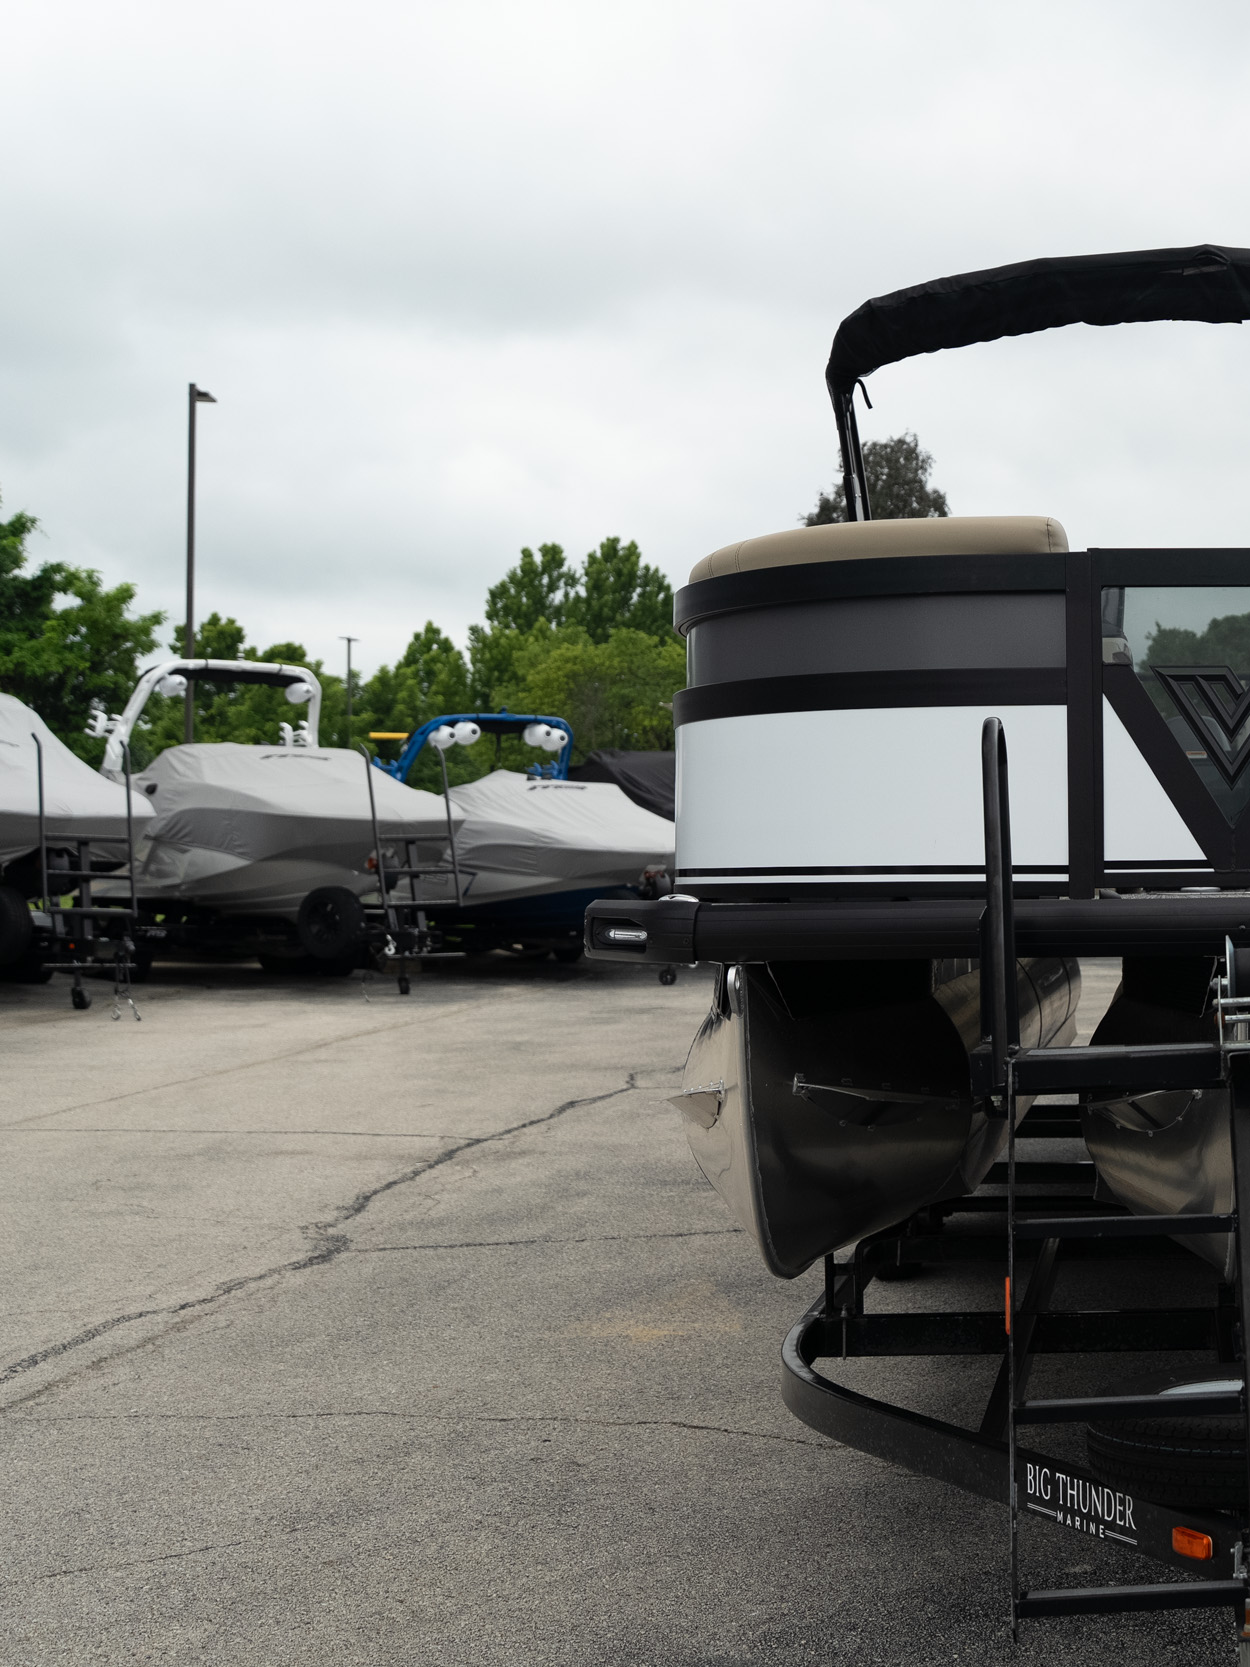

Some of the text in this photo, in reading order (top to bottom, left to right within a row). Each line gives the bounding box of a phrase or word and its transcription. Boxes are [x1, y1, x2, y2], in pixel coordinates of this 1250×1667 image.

[1026, 1463, 1137, 1530] BIG THUNDER
[1056, 1510, 1105, 1538] MARINE
